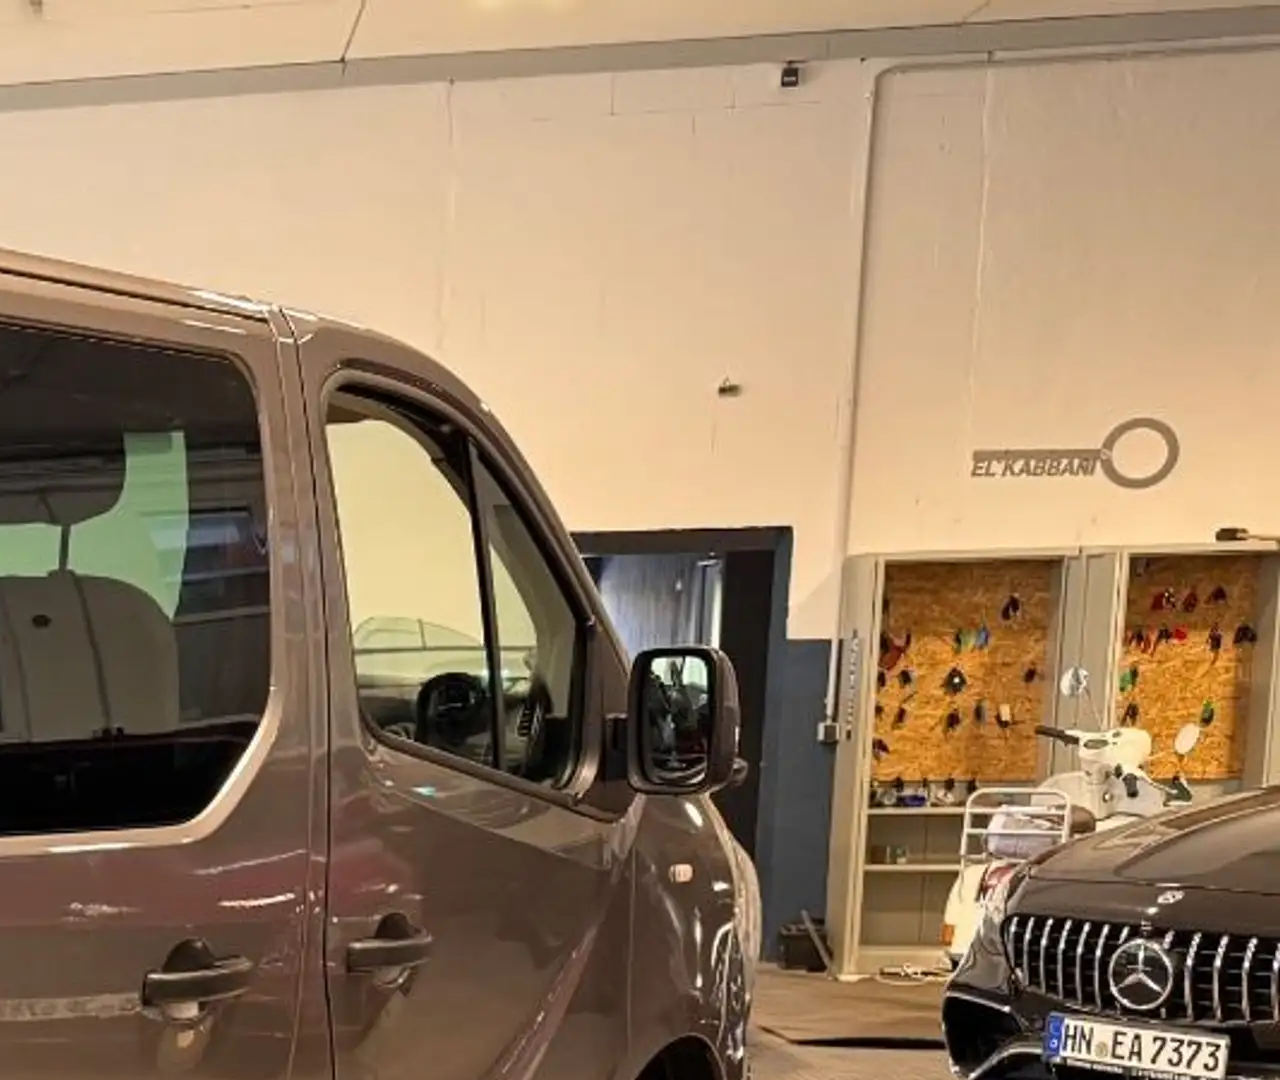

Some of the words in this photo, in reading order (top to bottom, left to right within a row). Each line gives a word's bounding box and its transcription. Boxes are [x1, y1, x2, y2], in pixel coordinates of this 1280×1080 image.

[971, 458, 996, 477] EL
[1001, 458, 1098, 477] KABBANI
[1063, 1023, 1094, 1055] HN
[1111, 1030, 1143, 1063] EA
[1150, 1035, 1222, 1073] 7373
